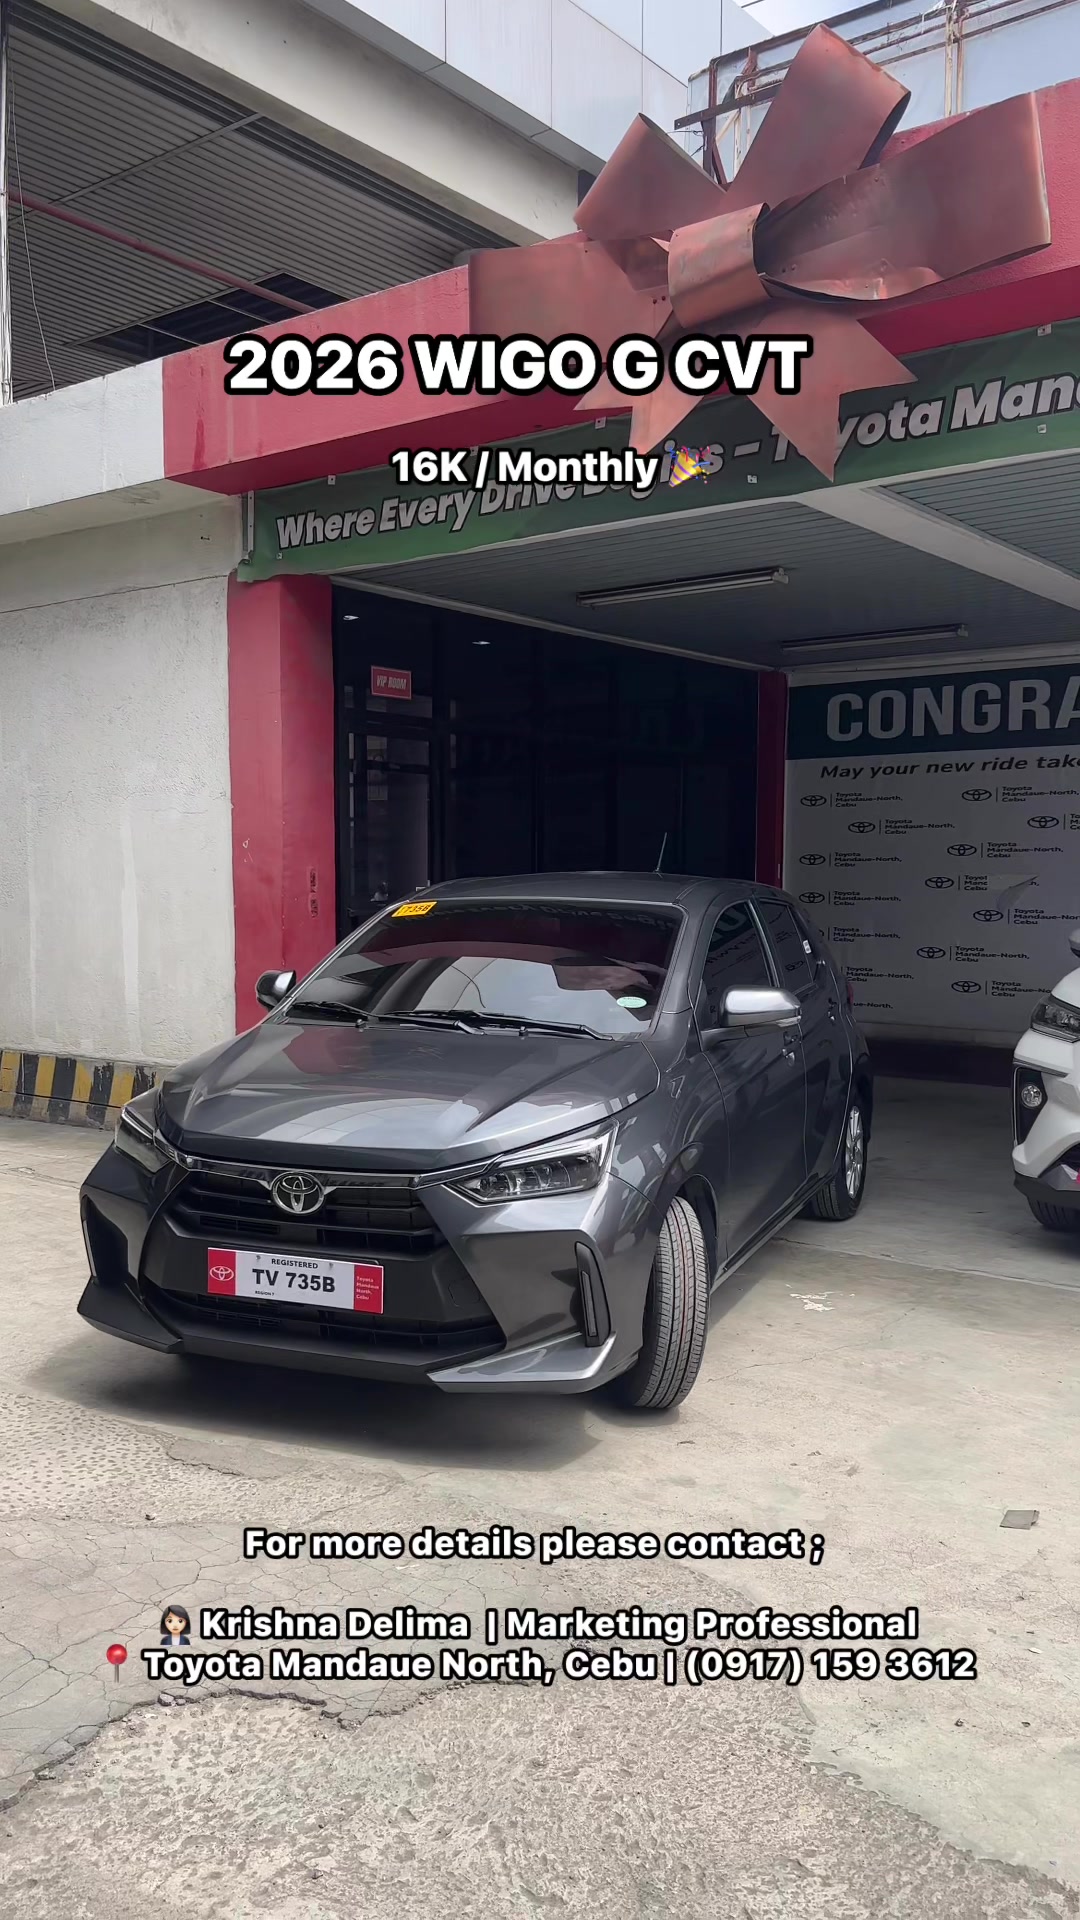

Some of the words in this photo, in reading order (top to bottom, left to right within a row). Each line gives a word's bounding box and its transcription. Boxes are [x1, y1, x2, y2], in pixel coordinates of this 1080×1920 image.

[276, 507, 376, 550] Where
[378, 490, 477, 533] Every
[770, 398, 944, 464] Tyota
[948, 372, 1080, 432] Man
[376, 675, 388, 688] VIP
[387, 676, 407, 690] ROOM
[820, 764, 864, 780] May
[870, 763, 920, 779] your
[926, 760, 975, 774] new
[981, 757, 1028, 772] ride
[271, 1258, 319, 1269] REGISTERED
[252, 1268, 279, 1286] TV
[285, 1272, 336, 1293] 735B
[356, 1275, 374, 1283] Toyota
